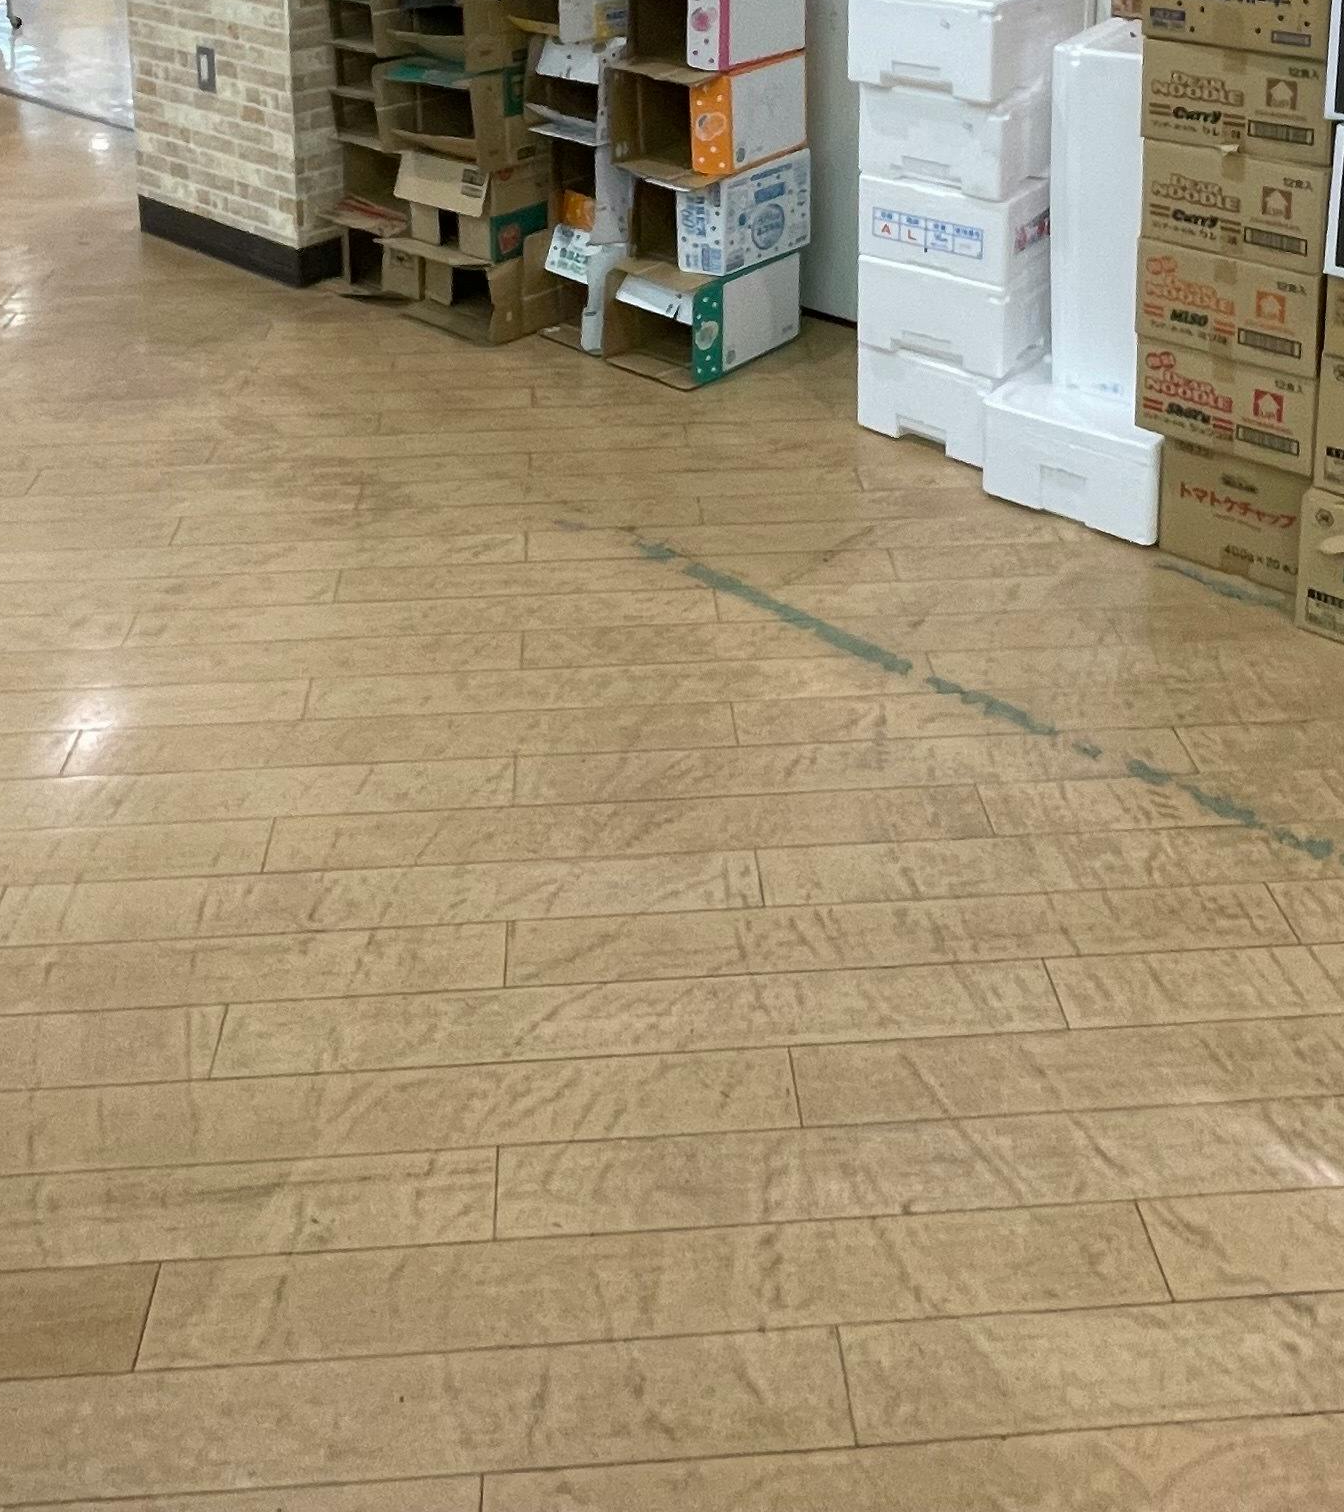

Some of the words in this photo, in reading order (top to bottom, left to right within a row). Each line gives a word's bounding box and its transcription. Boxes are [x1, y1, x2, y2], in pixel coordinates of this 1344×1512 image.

[1150, 77, 1245, 108] NOODLE
[1171, 105, 1222, 125] Curry
[1151, 180, 1242, 214] NOODLE
[880, 223, 892, 236] A
[907, 230, 917, 241] L
[1144, 375, 1234, 414] NOODLE
[1179, 481, 1297, 529] トマトケチャップ
